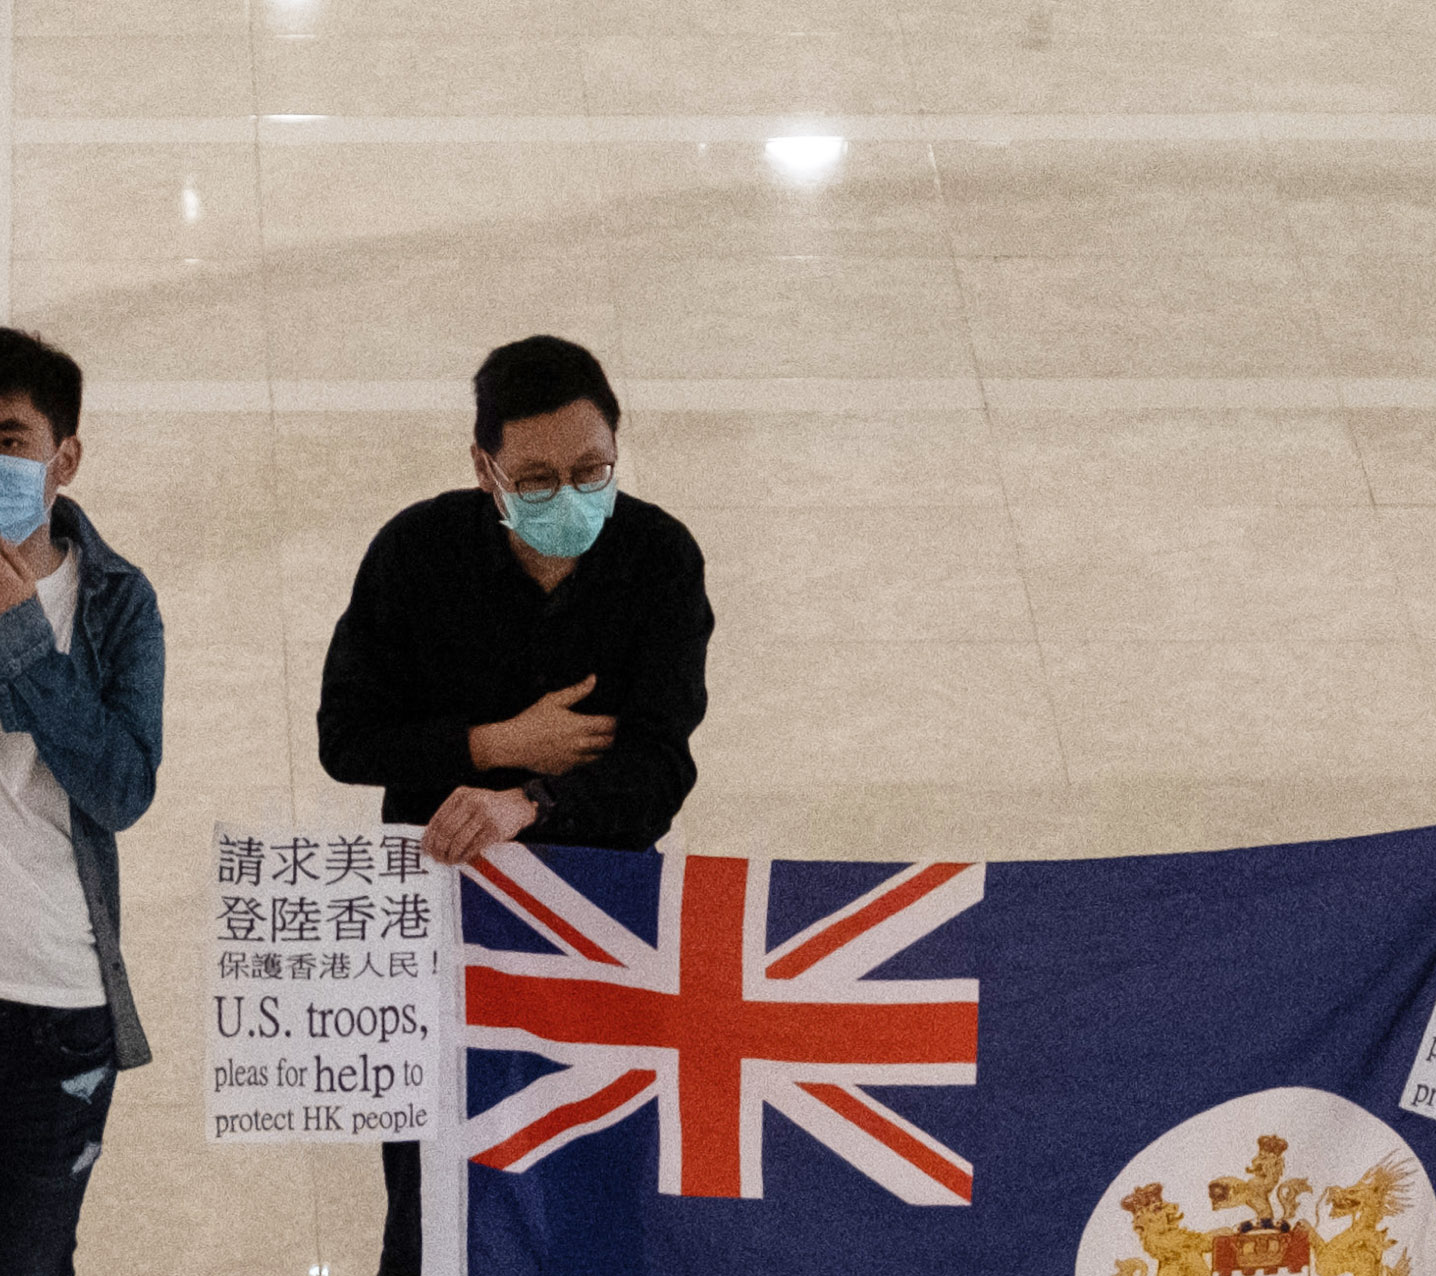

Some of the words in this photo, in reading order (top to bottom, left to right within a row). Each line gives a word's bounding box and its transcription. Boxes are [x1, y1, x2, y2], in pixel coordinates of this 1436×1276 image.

[218, 835, 428, 885] 請求美軍
[216, 894, 431, 942] 登陸香港
[214, 996, 291, 1038] U.S.
[307, 1001, 428, 1041] troops,
[215, 1058, 268, 1092] pleas
[277, 1057, 308, 1087] for
[314, 1054, 395, 1097] help
[403, 1055, 423, 1087] to
[215, 1107, 294, 1137] protect
[303, 1106, 344, 1130] HK
[352, 1104, 427, 1133] people
